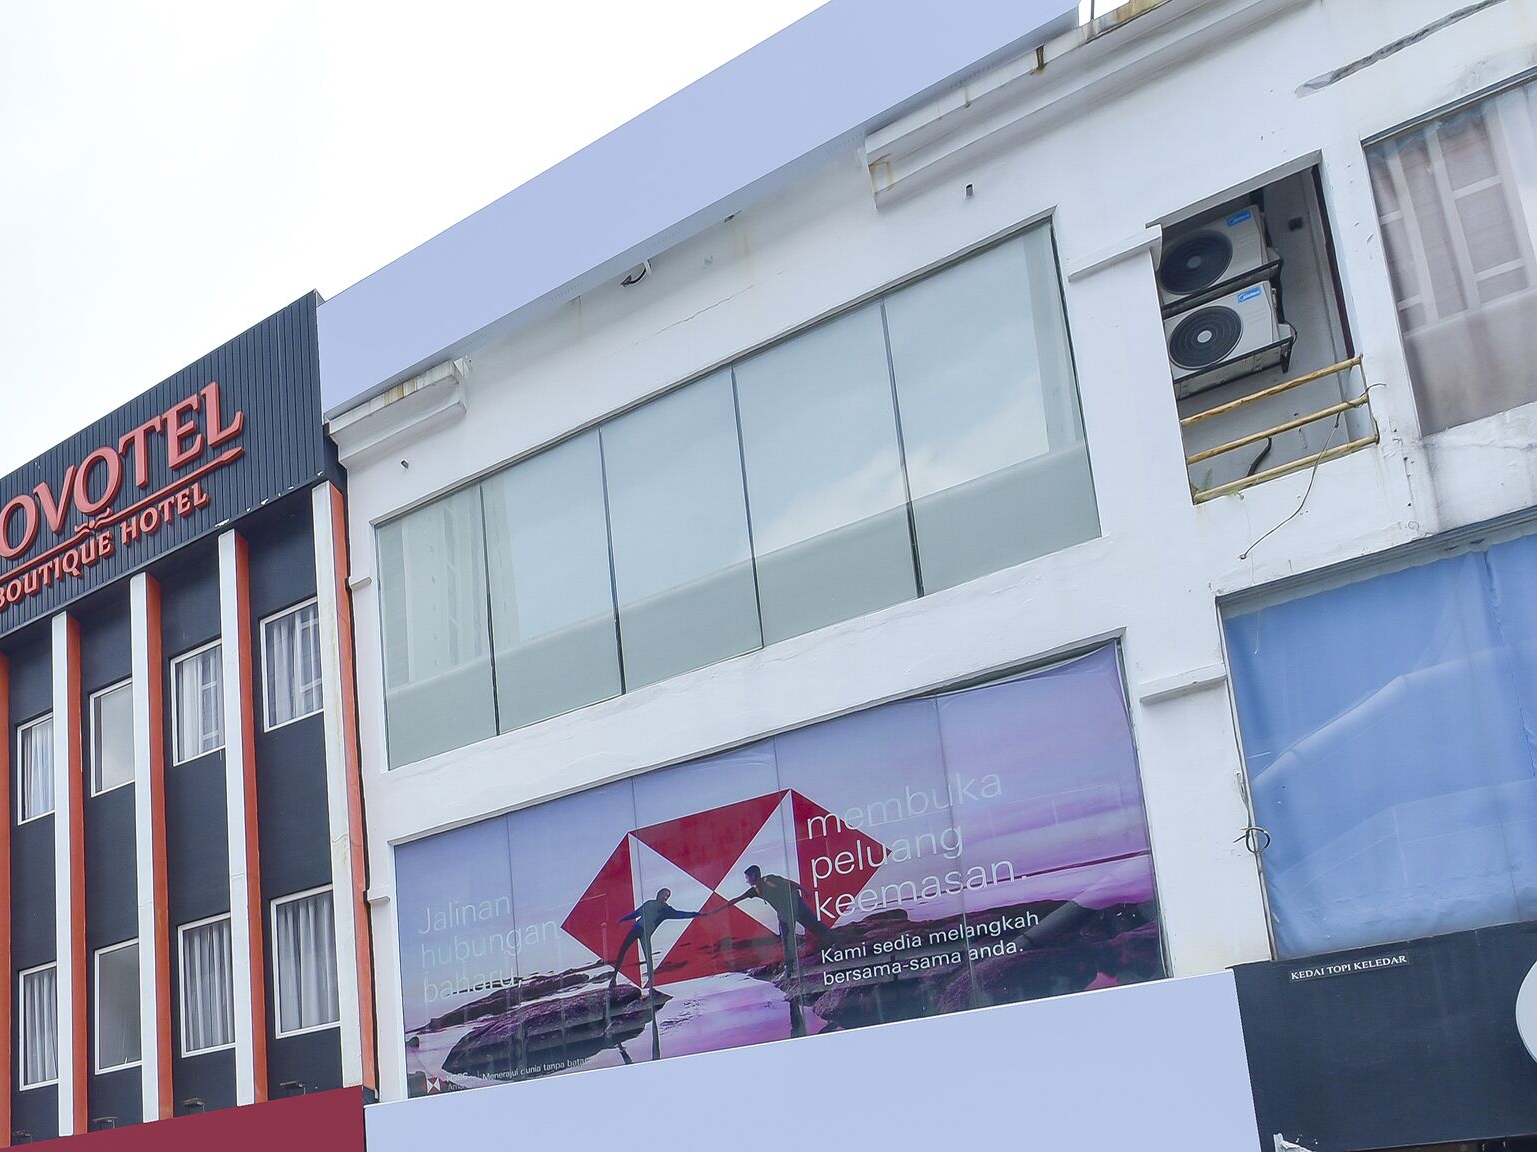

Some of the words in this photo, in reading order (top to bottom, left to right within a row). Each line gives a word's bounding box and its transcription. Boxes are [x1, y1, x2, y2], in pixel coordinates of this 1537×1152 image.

[121, 482, 210, 546] HOTEL
[807, 773, 1003, 840] membuka
[811, 826, 964, 888] peluang
[418, 896, 511, 935] Jalinan
[814, 859, 1028, 922] keemasan.
[421, 919, 559, 968] hubungan
[821, 942, 867, 964] Kami
[873, 933, 922, 955] sedia
[929, 911, 1040, 946] melangkah
[823, 952, 961, 986] bersama-sama
[969, 940, 1024, 962] anda.
[1291, 968, 1324, 980] KEDAI
[1326, 964, 1351, 975] TOPI
[1354, 955, 1407, 971] KELEDAR
